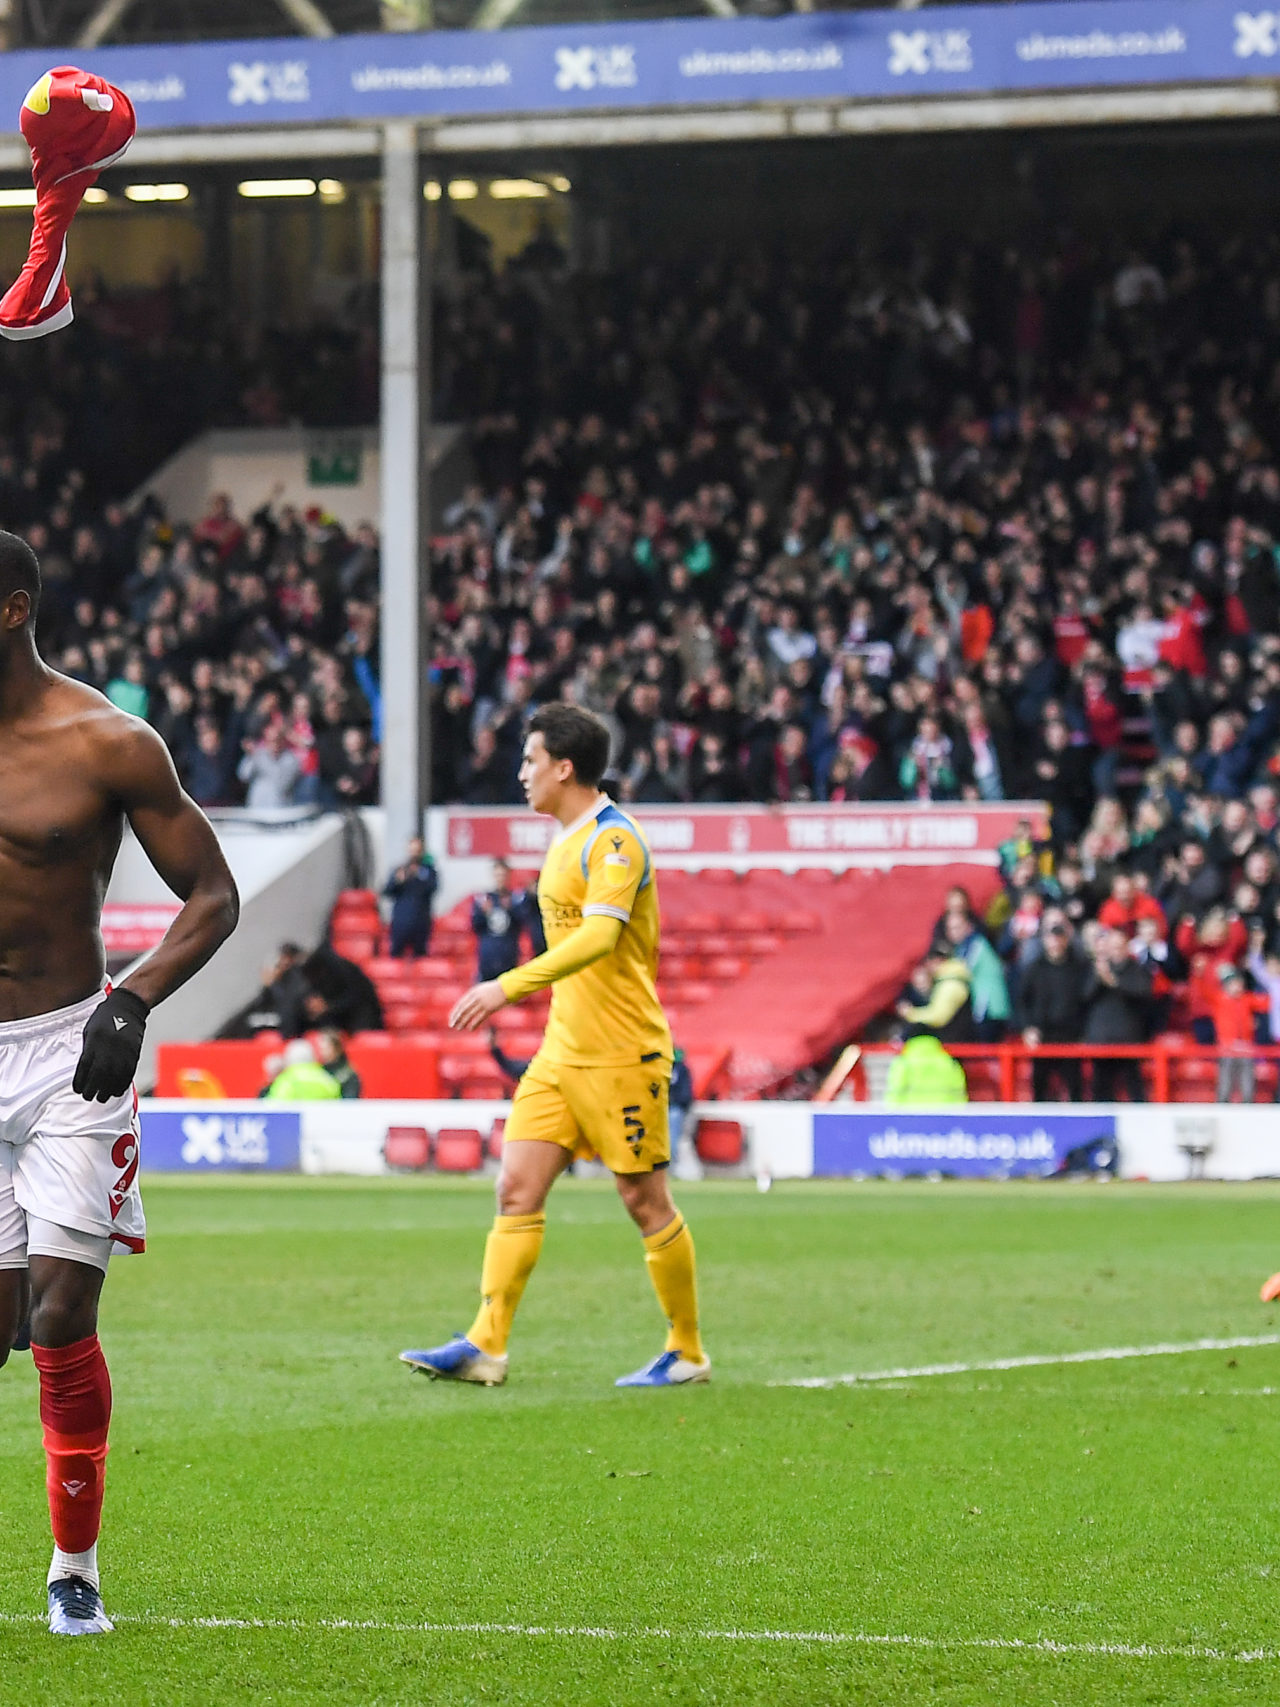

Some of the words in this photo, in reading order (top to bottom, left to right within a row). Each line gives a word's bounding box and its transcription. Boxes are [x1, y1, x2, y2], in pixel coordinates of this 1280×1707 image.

[787, 816, 826, 848] THE
[622, 1105, 645, 1143] 5
[869, 1127, 1054, 1159] ukmeds.co.uk
[111, 1133, 140, 1193] 9
